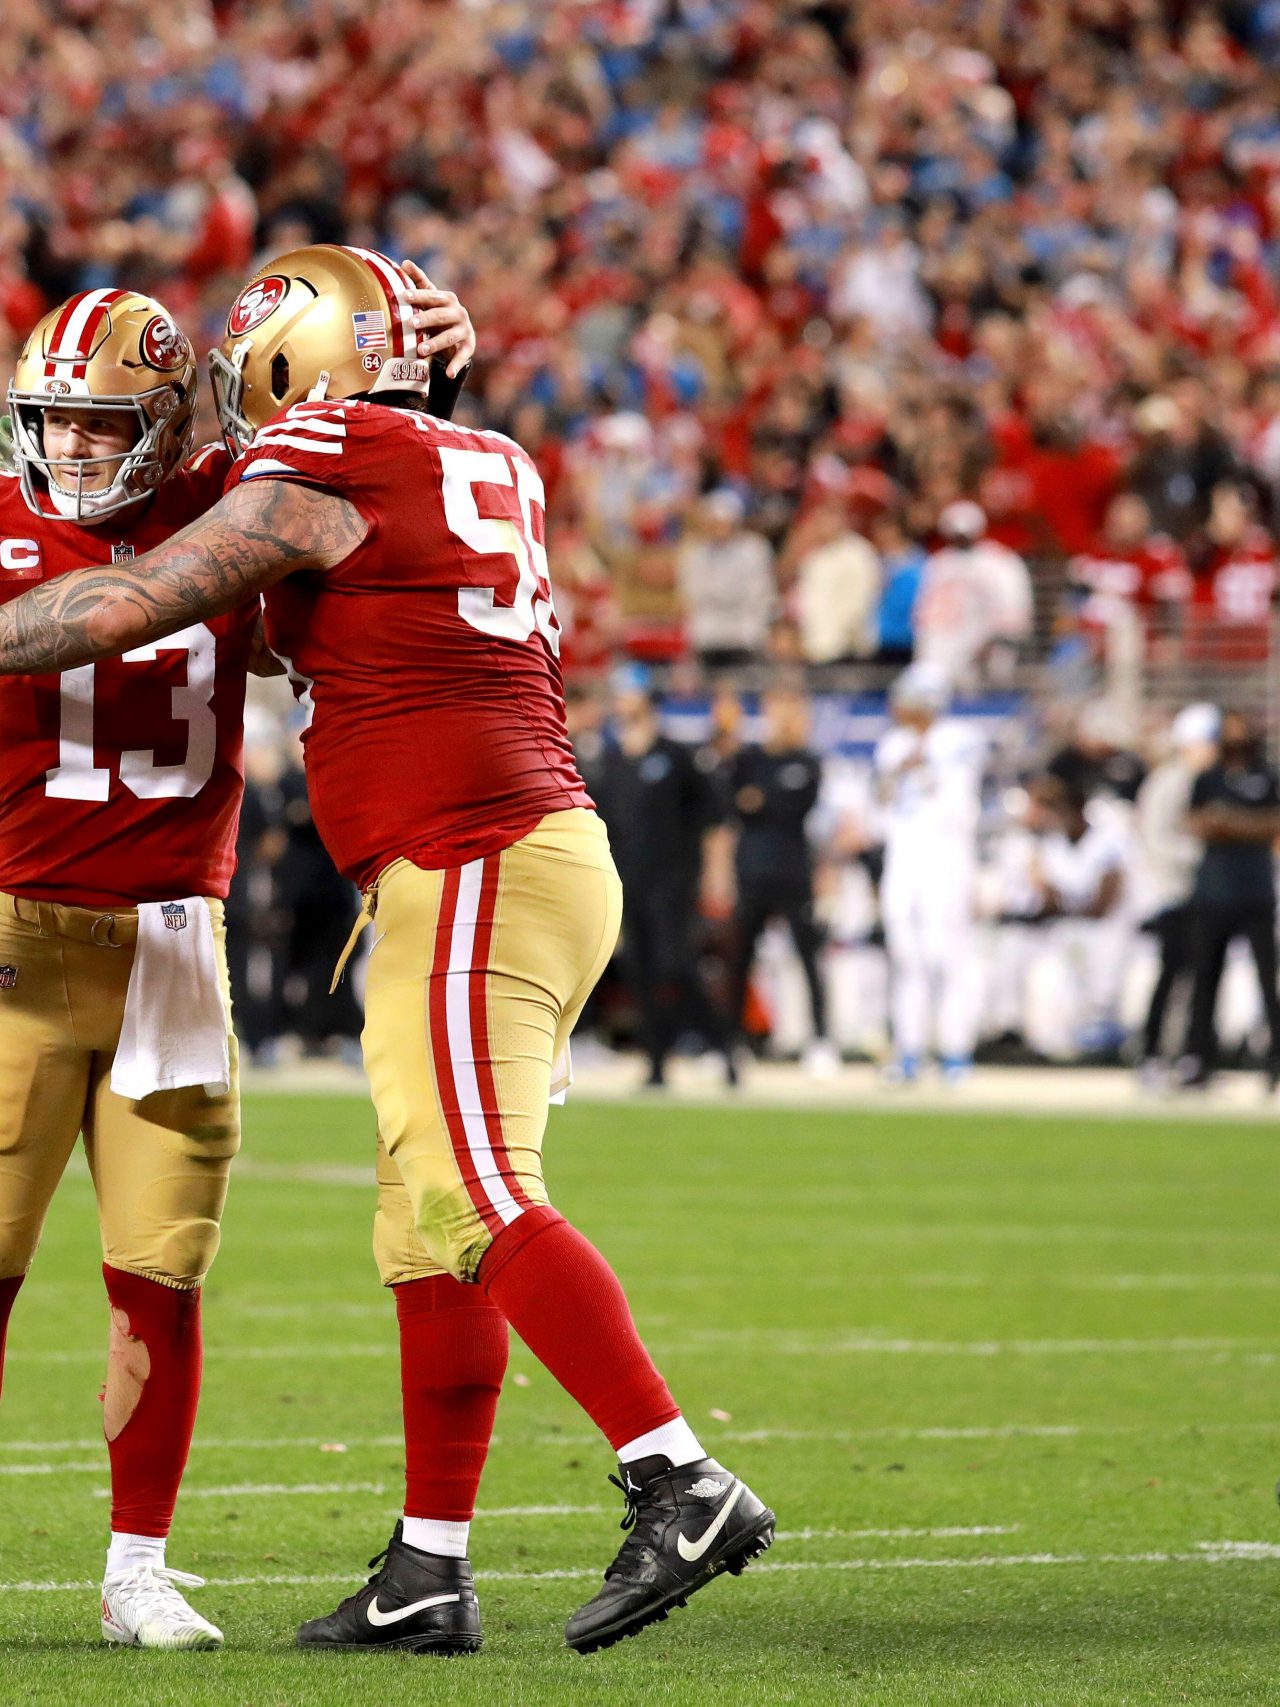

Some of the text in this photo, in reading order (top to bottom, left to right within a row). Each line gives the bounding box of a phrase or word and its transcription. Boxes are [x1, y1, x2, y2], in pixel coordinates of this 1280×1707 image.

[239, 282, 278, 327] SF
[365, 356, 380, 369] 64
[0, 539, 39, 569] C
[437, 447, 562, 658] 55
[45, 622, 216, 802] 13
[166, 914, 185, 927] NFL
